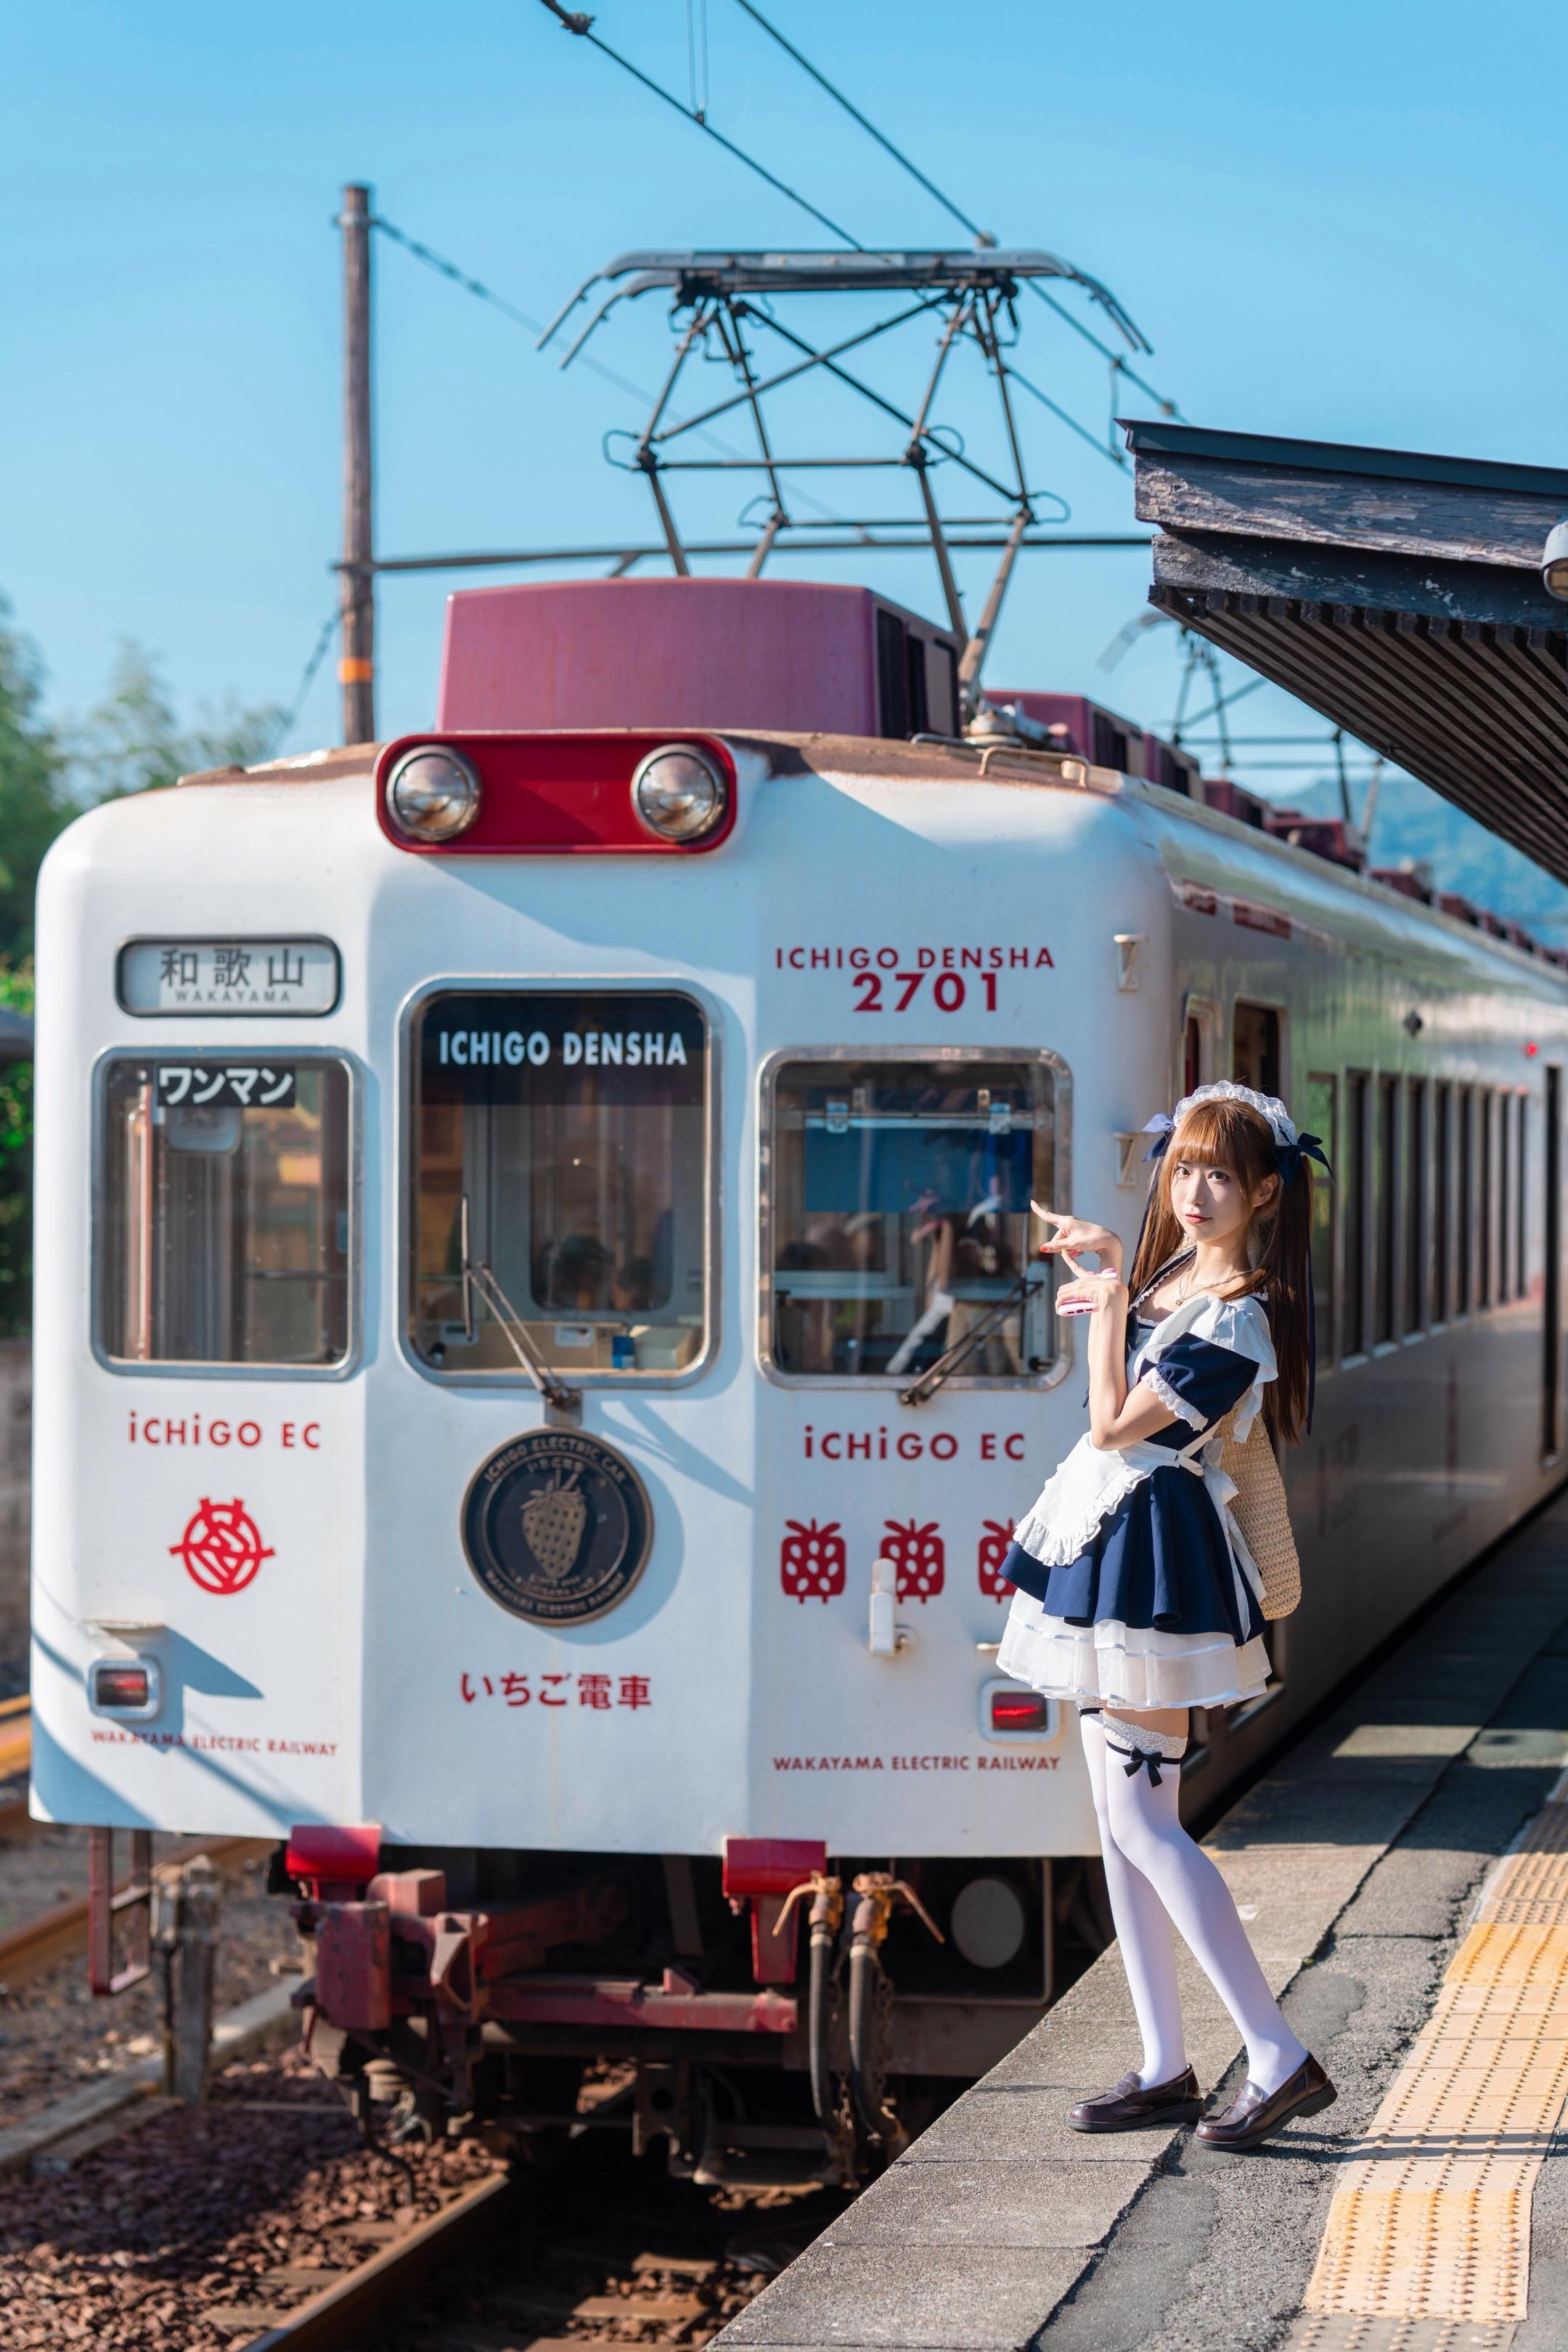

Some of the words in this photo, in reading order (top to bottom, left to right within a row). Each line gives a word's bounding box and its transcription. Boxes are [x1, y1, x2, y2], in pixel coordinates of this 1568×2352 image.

[159, 947, 305, 988] 和歌山
[775, 947, 899, 970] ICHIGO
[918, 947, 1055, 969] DENSHA
[175, 989, 290, 1003] WAKAYAMA
[852, 972, 998, 1013] 2701
[440, 1031, 551, 1066] ICHIGO
[563, 1032, 688, 1066] DENSHA
[158, 1067, 293, 1105] ワンマン
[281, 1422, 321, 1449] EC
[980, 1432, 1025, 1461] EC
[460, 1672, 652, 1710] いちご電車
[91, 1730, 184, 1747] WAKAYAMA
[192, 1736, 261, 1752] ELECTRIC
[267, 1741, 338, 1756] RAILWAY
[773, 1757, 885, 1771] WAKAYAMA
[891, 1756, 969, 1771] ELECTRIC
[977, 1755, 1061, 1771] RAILWAY
